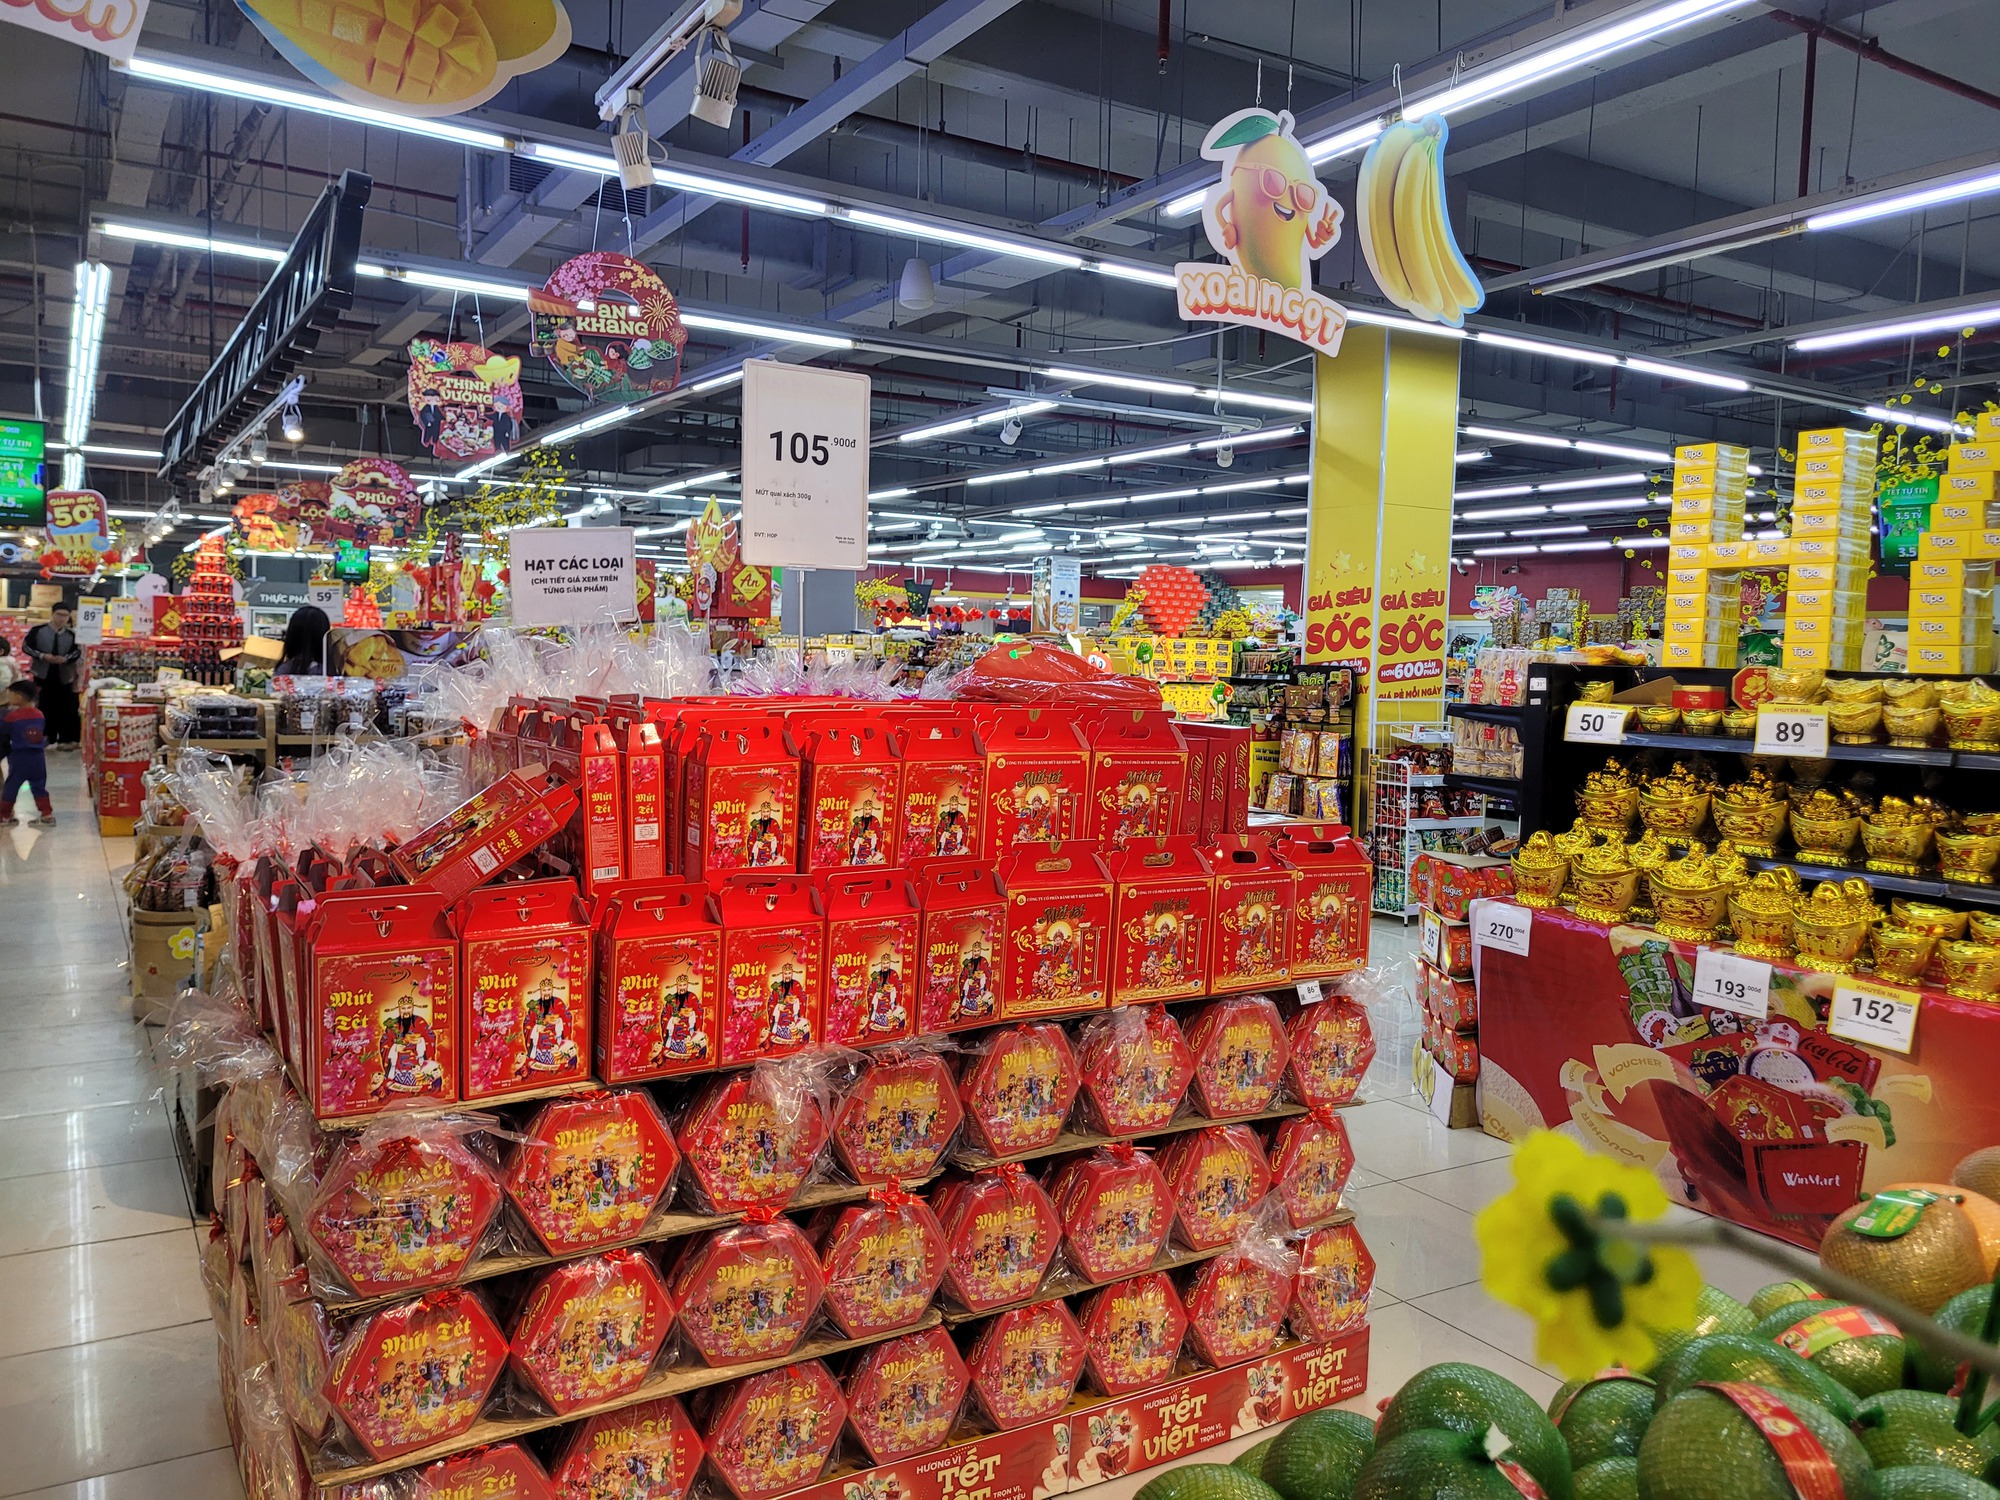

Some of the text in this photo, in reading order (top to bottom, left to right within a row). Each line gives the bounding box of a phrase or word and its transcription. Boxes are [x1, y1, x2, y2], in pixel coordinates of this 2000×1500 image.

[769, 430, 830, 466] 105
[1683, 448, 1703, 460] Tipo
[1805, 461, 1828, 472] Tipo
[1950, 478, 1977, 490] Tipo
[355, 491, 397, 506] PHÚC
[301, 505, 326, 520] LỘC
[1895, 511, 1910, 520] 3.5
[1678, 523, 1698, 534] Tipo
[1756, 543, 1778, 554] Tipo
[1800, 540, 1822, 552] Tipo
[1897, 546, 1918, 558] 3.5
[524, 555, 624, 574] HẠT CÁC LOẠI
[1922, 565, 1948, 576] Tipo
[567, 575, 581, 583] GIÁ
[599, 574, 619, 582] TRÊN
[317, 591, 332, 601] 59
[1307, 586, 1372, 612] GIÁ SIÊU
[1380, 588, 1445, 611] GIÁ SIÊU
[83, 610, 96, 622] 89
[1305, 611, 1371, 655] SỐC
[1378, 614, 1444, 656] SỐC
[1672, 621, 1691, 632] Tipo
[1794, 620, 1816, 632] Tipo
[1919, 649, 1944, 661] Tipo
[1394, 661, 1424, 679] 600
[1421, 685, 1443, 697] NGÀY
[1578, 713, 1604, 732] 50
[1775, 722, 1805, 742] 89
[713, 799, 746, 816] Mứt
[819, 795, 850, 813] Mứt
[907, 792, 937, 808] Mứt
[822, 816, 845, 833] Tết
[909, 811, 933, 826] Tết
[716, 819, 742, 837] Tết
[1441, 884, 1464, 897] sugus
[1489, 921, 1514, 940] 270
[731, 961, 767, 979] Mứt
[478, 972, 518, 991] Mứt
[621, 972, 660, 991] Mứt
[1714, 978, 1746, 999] 193
[329, 988, 374, 1007] Mứt
[735, 983, 762, 1001] Tết
[483, 992, 514, 1013] Tết
[625, 994, 655, 1015] Tết
[1851, 996, 1895, 1024] 152
[336, 1009, 369, 1031] Tết
[1608, 1058, 1663, 1077] VOUCHER
[555, 1120, 639, 1151] Mứt Tết
[1782, 1171, 1841, 1187] WinMart
[975, 1200, 1037, 1231] Mứt Tết
[380, 1318, 473, 1359] Mứt Tết
[1292, 1348, 1322, 1363] HƯƠNG VỊ
[1305, 1341, 1347, 1380] TẾT
[1340, 1378, 1353, 1386] TRỌN
[1340, 1385, 1352, 1394] TRỌN
[1143, 1393, 1178, 1411] HƯƠNG VỊ
[1292, 1375, 1341, 1411] VIỆT
[1158, 1386, 1207, 1429] TẾT
[1199, 1424, 1213, 1435] TRỌN
[1199, 1433, 1213, 1444] TRỌN
[1142, 1422, 1199, 1461] VIỆT
[916, 1455, 962, 1475] HƯƠNG VỊ
[936, 1446, 1001, 1494] TẾT
